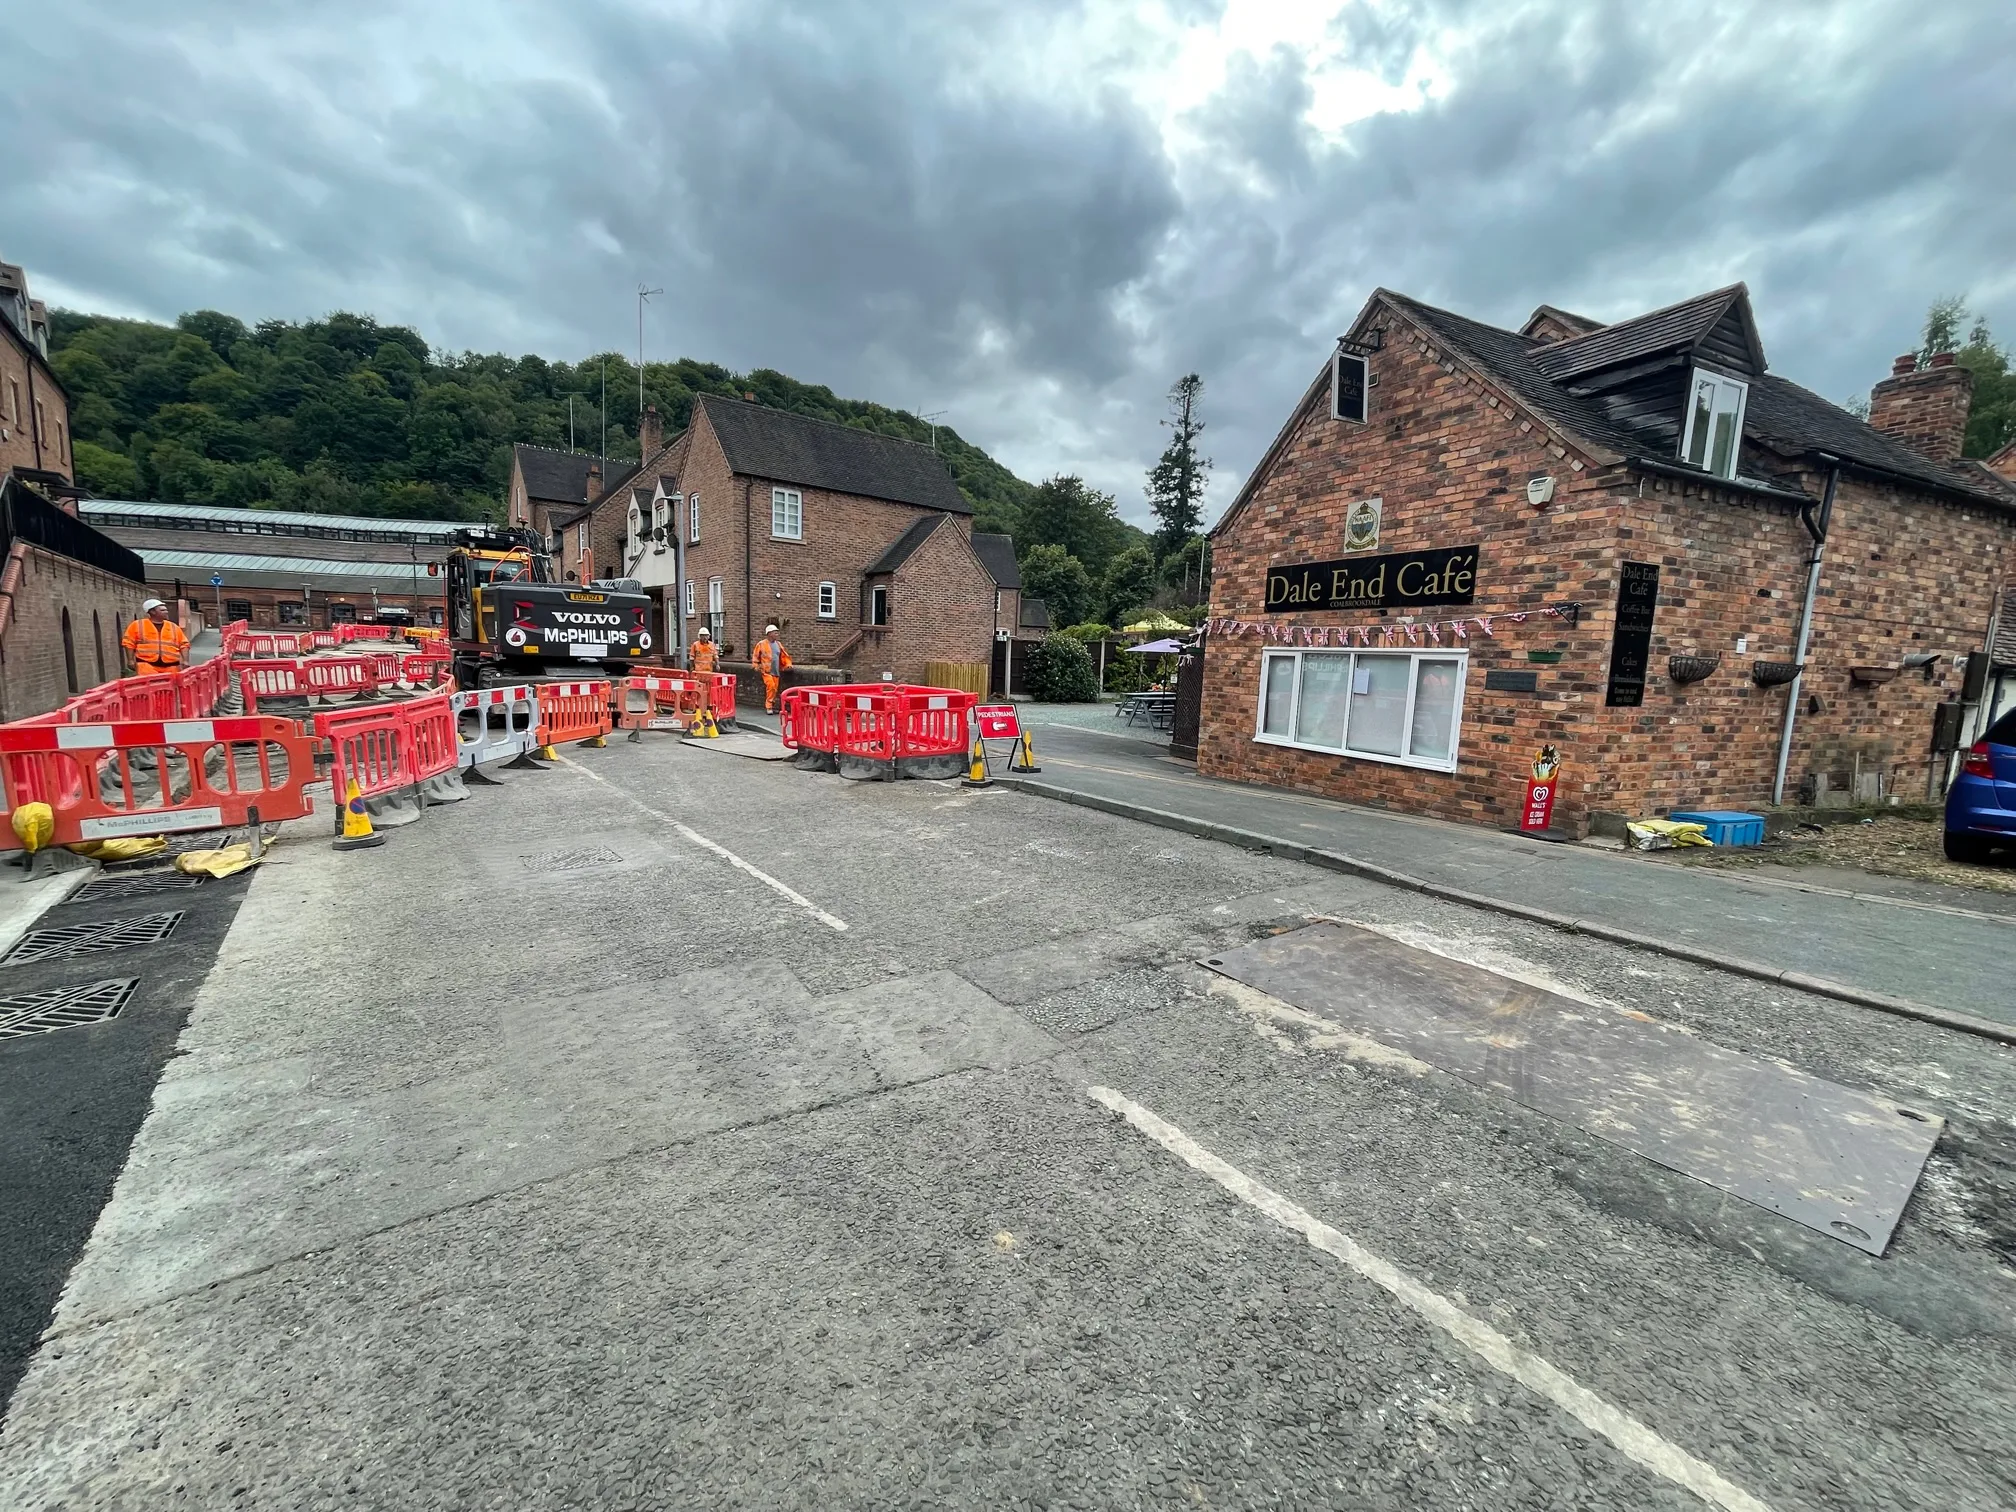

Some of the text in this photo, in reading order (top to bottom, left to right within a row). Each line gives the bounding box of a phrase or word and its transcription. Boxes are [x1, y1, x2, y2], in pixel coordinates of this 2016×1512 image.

[1267, 555, 1473, 605] Dale End Café
[1623, 566, 1658, 581] Dale End
[1630, 582, 1649, 595] Café
[1330, 599, 1382, 608] COALBROOKDALE
[552, 611, 621, 625] VOLVO
[544, 628, 628, 645] McPHILLIPS
[107, 815, 171, 828] McPHILLIPS
